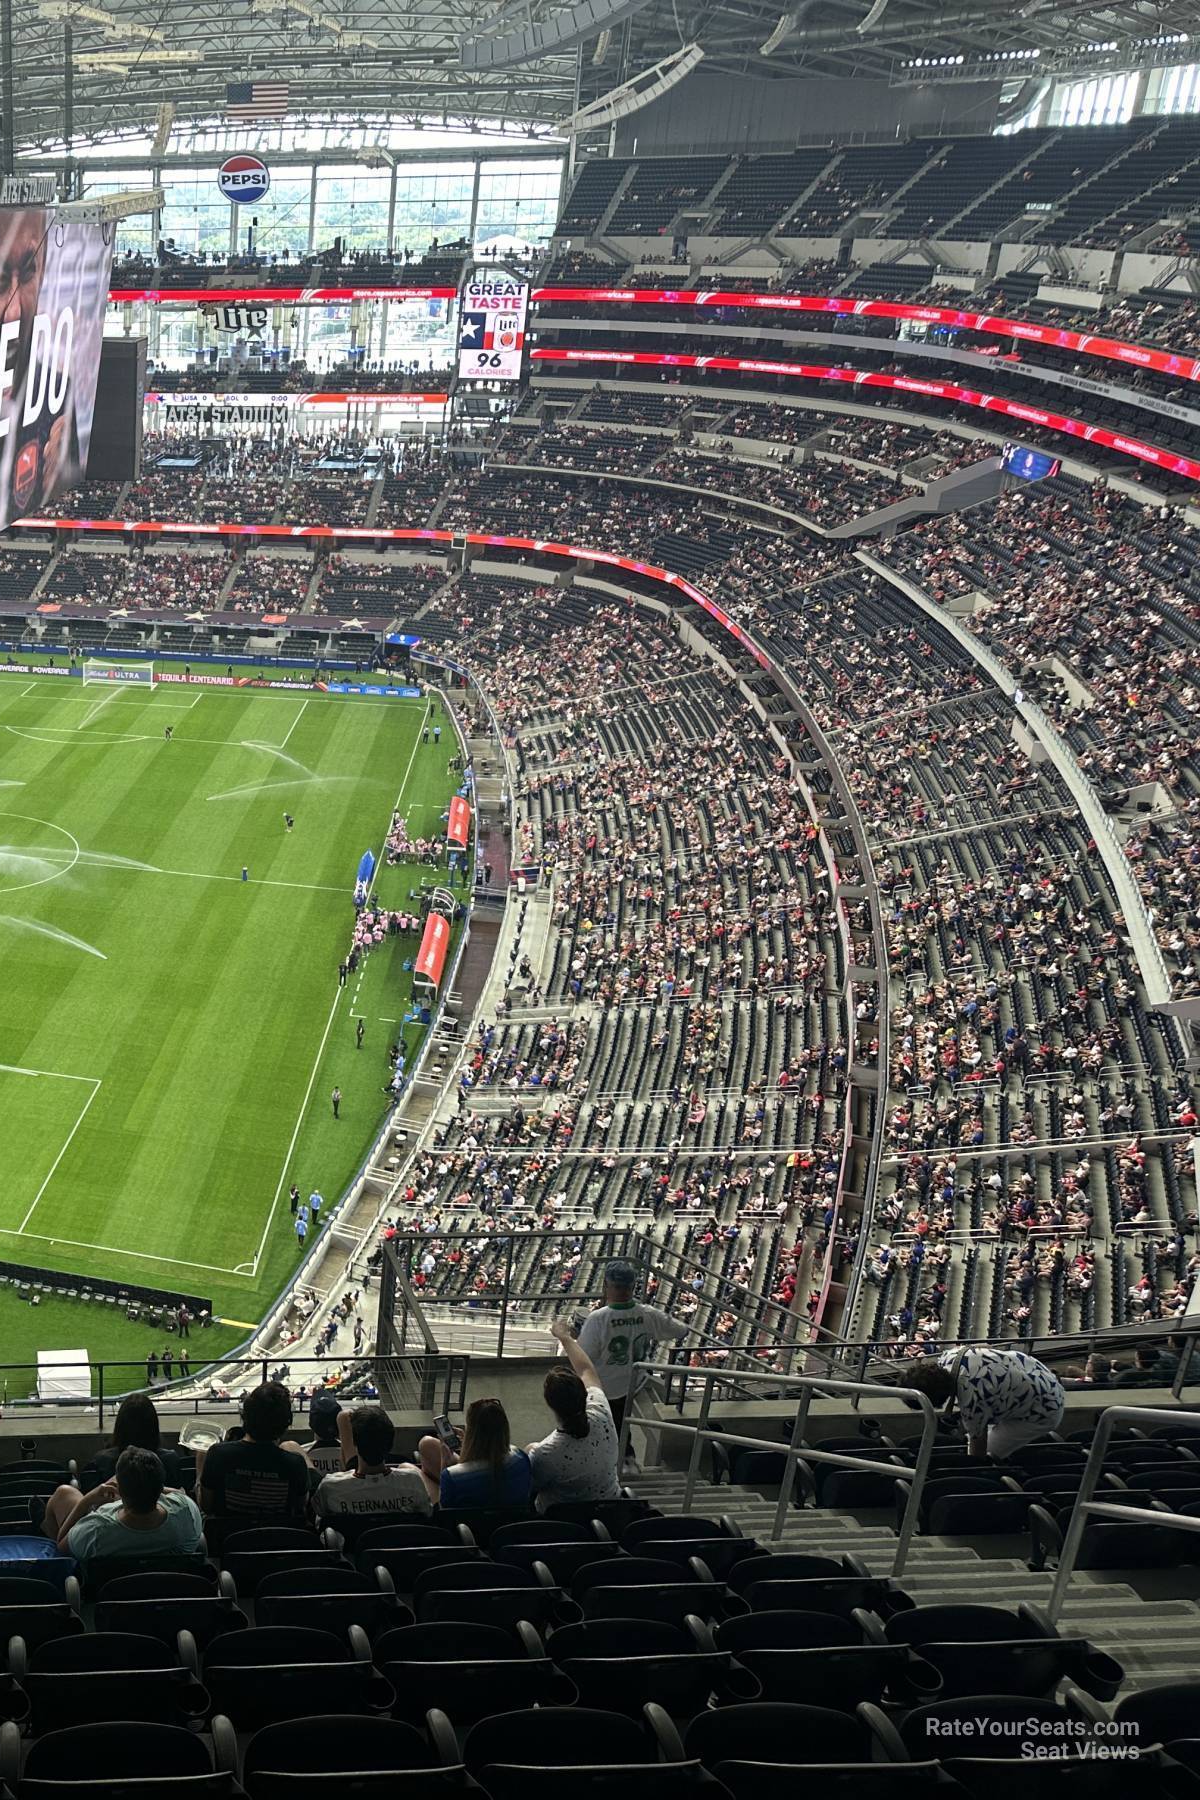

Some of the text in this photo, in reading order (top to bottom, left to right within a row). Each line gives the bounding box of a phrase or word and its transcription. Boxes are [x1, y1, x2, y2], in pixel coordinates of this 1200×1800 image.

[221, 174, 266, 185] PEPSI
[353, 289, 433, 298] store.copaamerica.com
[469, 284, 525, 295] GREAT
[470, 297, 522, 309] TASTE
[214, 306, 267, 333] Lite
[499, 319, 517, 331] Lite
[477, 353, 502, 367] 96
[23, 306, 74, 428] DO
[467, 368, 513, 376] CALORIES
[167, 406, 288, 423] AT&T STADIUM
[32, 667, 70, 675] POWERADE
[114, 671, 140, 679] ULTRA
[158, 673, 234, 685] TEQUILA CENTENARIO
